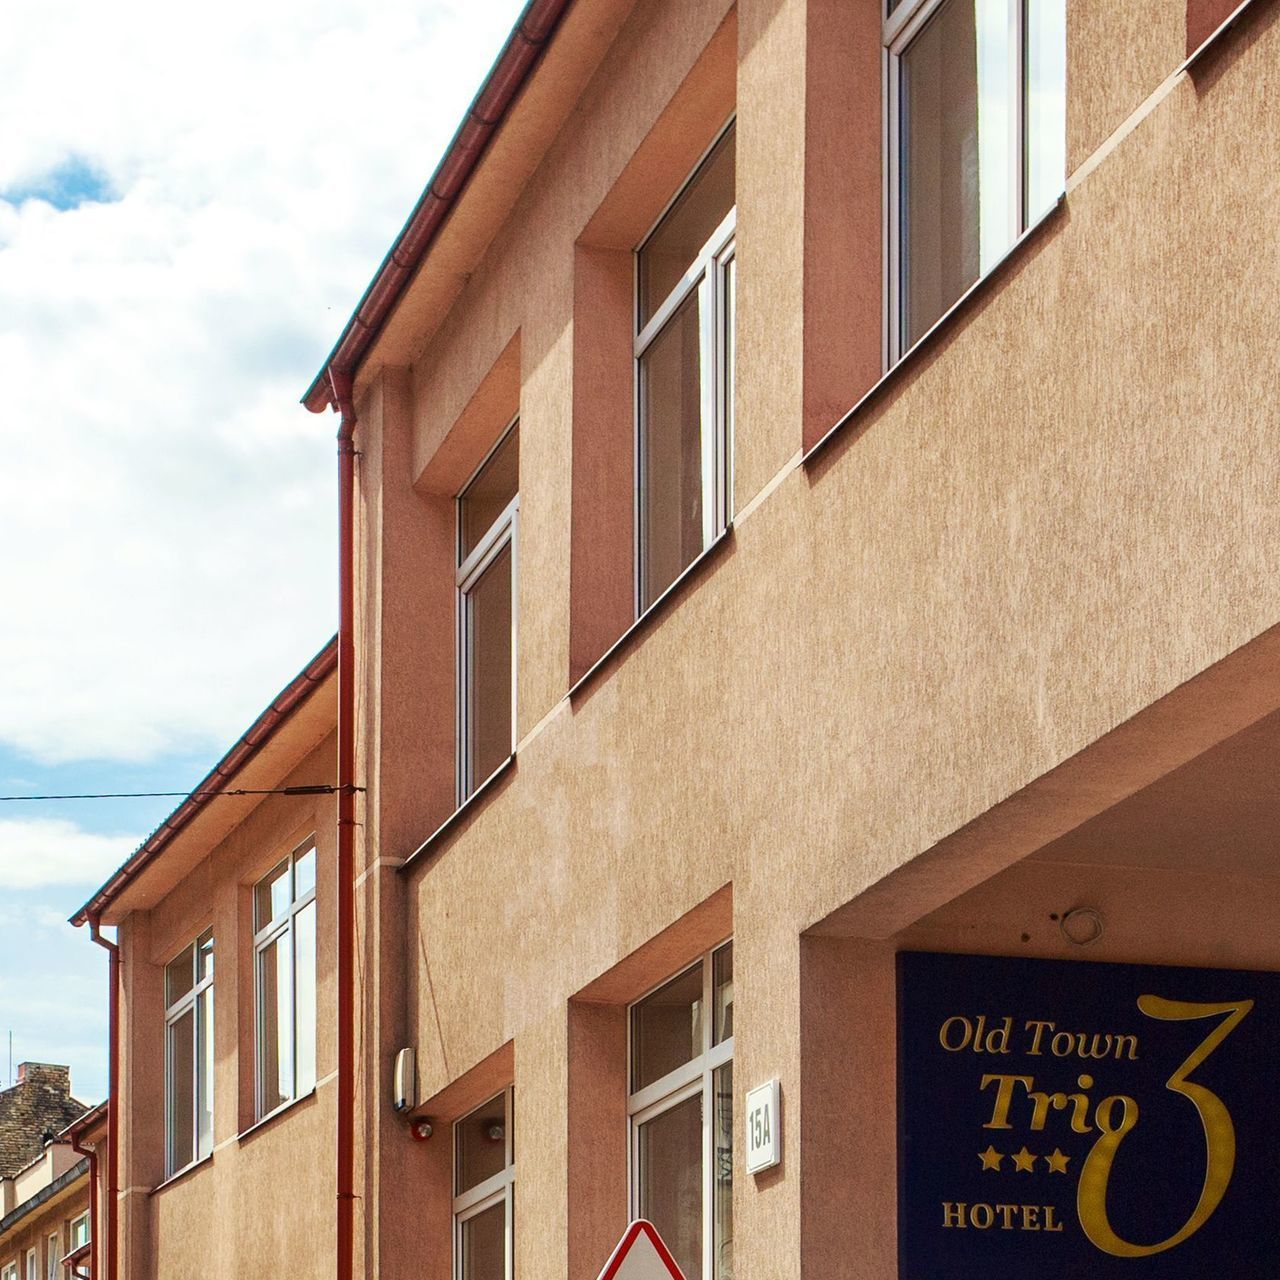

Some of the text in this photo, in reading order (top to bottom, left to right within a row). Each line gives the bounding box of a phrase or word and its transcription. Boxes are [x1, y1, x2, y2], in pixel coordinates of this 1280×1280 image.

[939, 1015, 1139, 1061] Old Town
[749, 1103, 771, 1152] 15A
[979, 1073, 1140, 1135] Trio
[942, 1201, 1064, 1232] HOTEL
